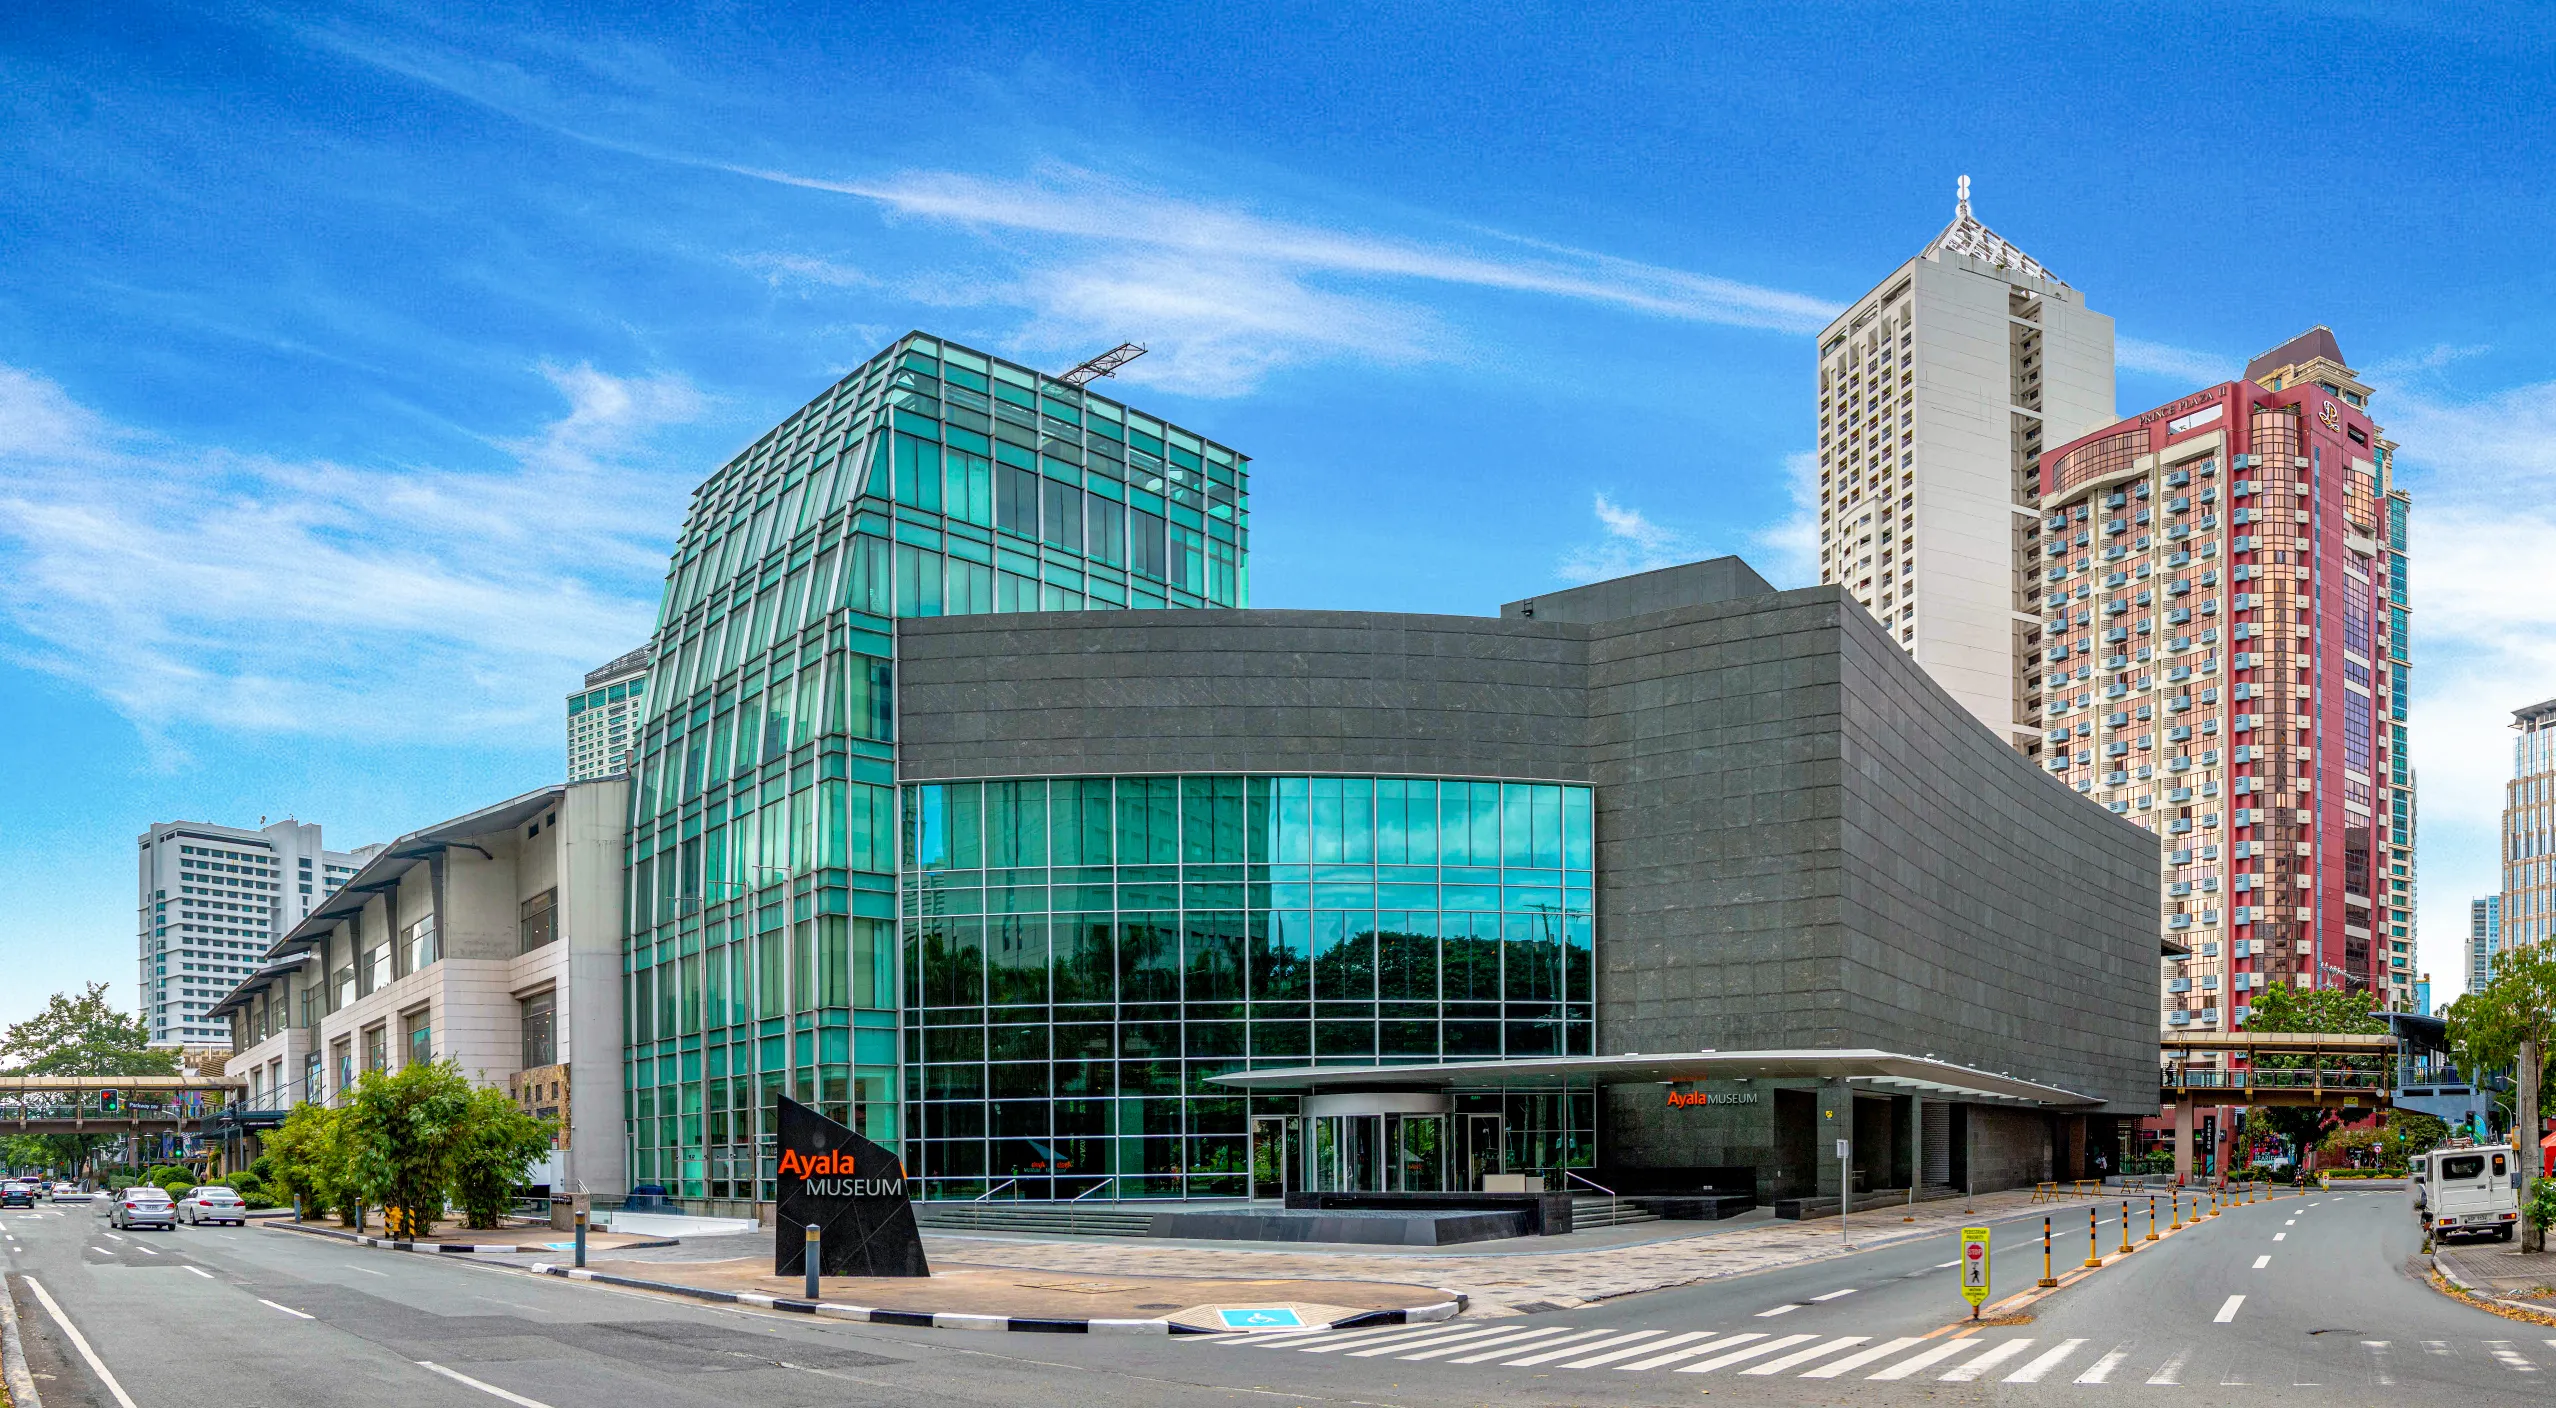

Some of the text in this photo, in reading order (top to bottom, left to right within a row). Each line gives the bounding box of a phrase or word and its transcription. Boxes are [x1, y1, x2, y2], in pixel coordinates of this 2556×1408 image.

[2138, 385, 2227, 427] PRINCE PLAZA II
[1667, 1090, 1757, 1109] Ayala MUSEUM
[778, 1149, 855, 1180] Ayala
[806, 1179, 901, 1196] MUSEUM
[1967, 1248, 1983, 1256] STOP
